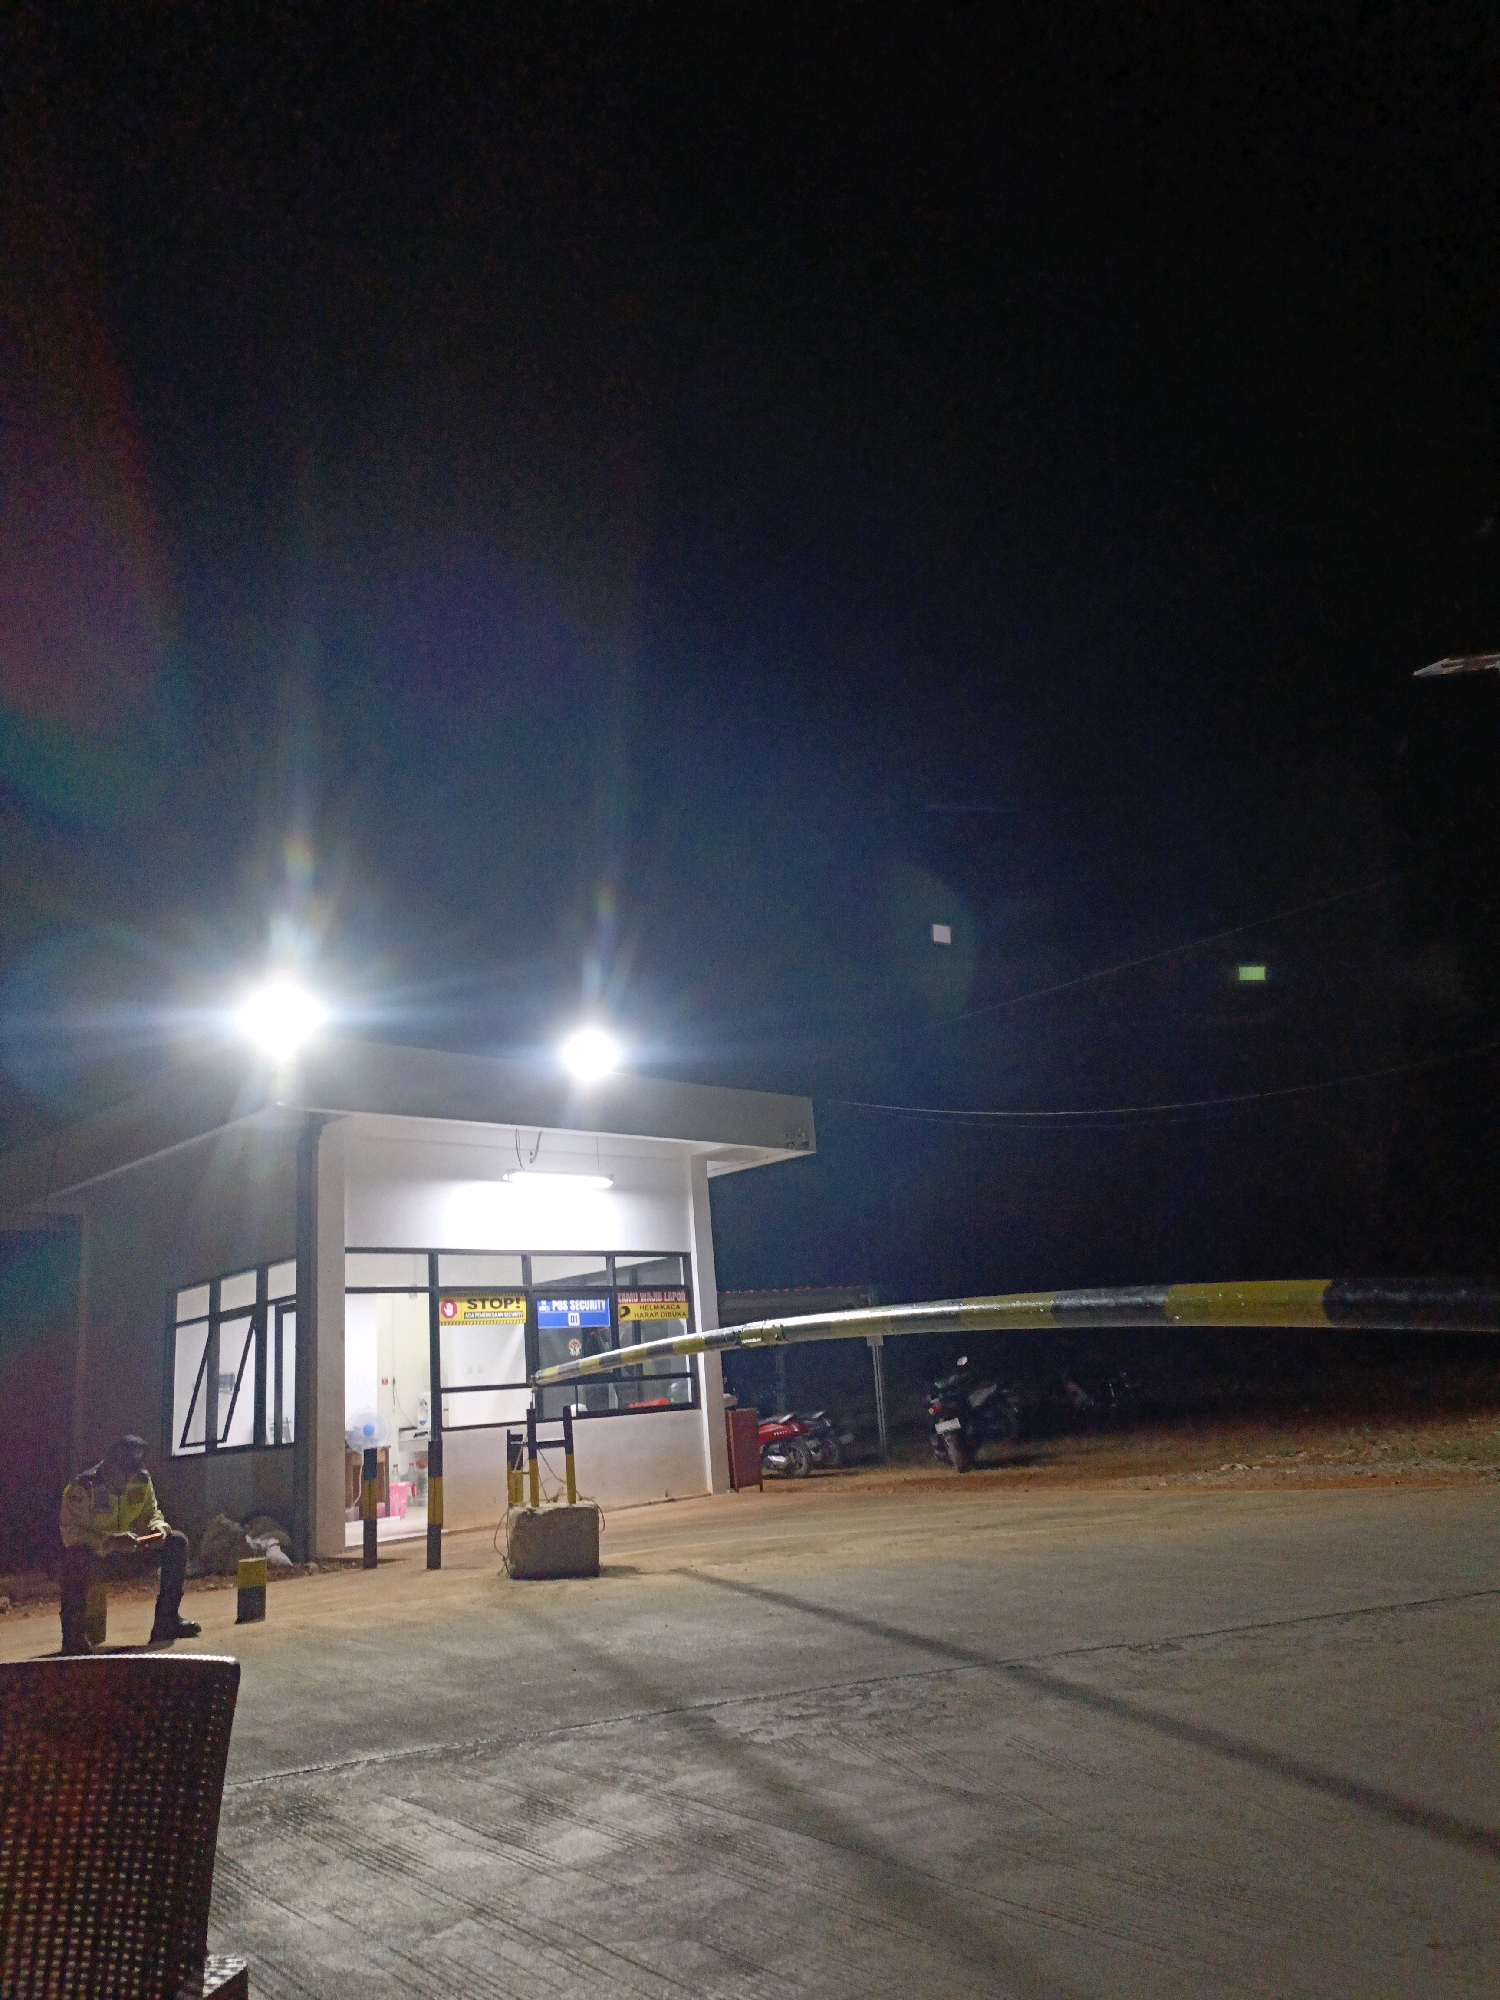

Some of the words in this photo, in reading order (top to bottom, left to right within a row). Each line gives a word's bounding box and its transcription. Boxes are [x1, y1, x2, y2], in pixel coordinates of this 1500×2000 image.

[617, 1292, 638, 1303] TAMU
[640, 1291, 662, 1302] WAJIB
[664, 1290, 686, 1302] LAPOR
[467, 1297, 520, 1309] STOP!
[552, 1300, 568, 1311] POS
[569, 1299, 606, 1311] SECURITY
[570, 1314, 578, 1324] 01
